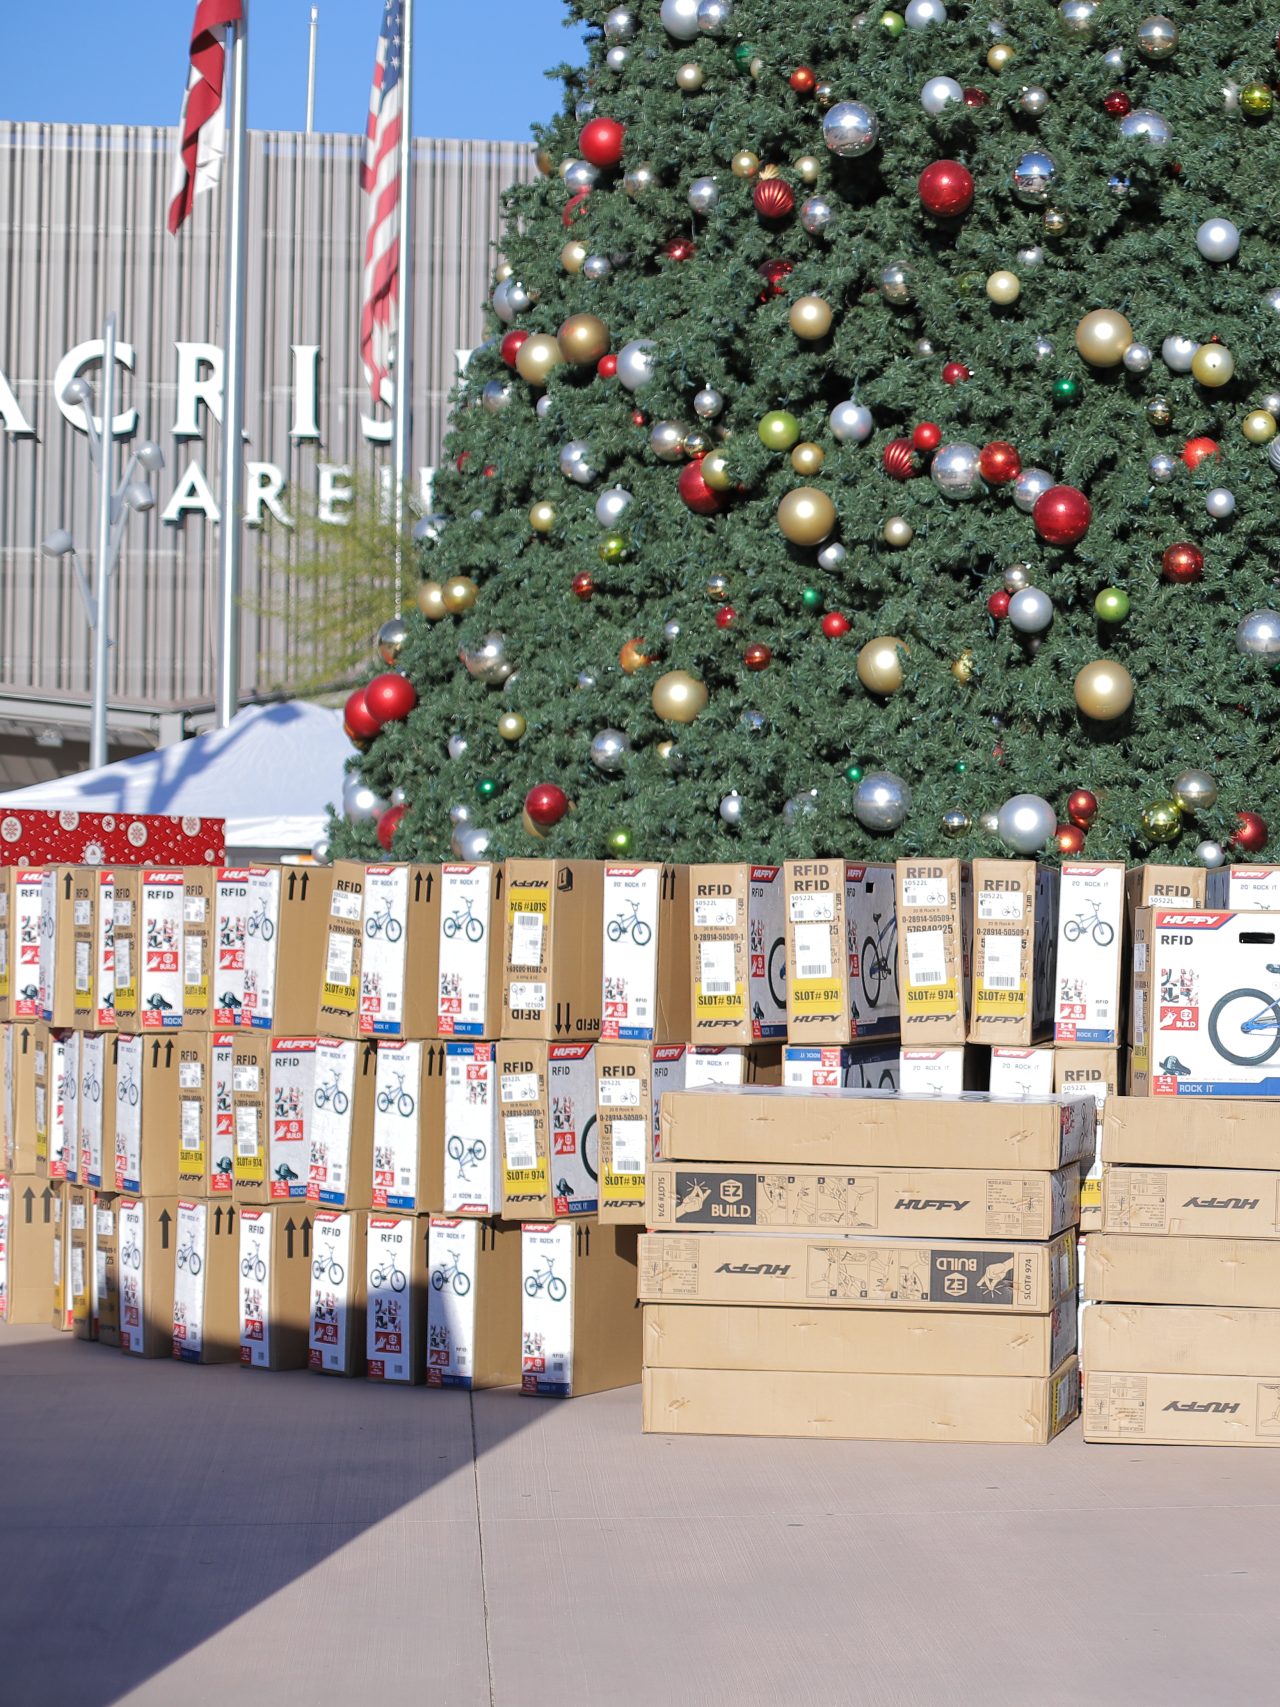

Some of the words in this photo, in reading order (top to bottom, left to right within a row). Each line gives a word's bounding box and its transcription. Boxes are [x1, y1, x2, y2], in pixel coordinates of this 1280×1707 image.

[793, 865, 829, 876] RFID
[906, 866, 943, 878] RFID
[186, 886, 204, 895] RFID
[337, 879, 363, 894] RFID
[697, 884, 732, 896] RFID
[794, 880, 830, 891] RFID
[984, 879, 1021, 891] RFID
[1154, 884, 1191, 897] RFID
[148, 891, 174, 900] RFID
[220, 889, 247, 898] RFID
[1162, 915, 1220, 926] HUFFY
[1161, 935, 1194, 945] RFID
[698, 995, 725, 1006] SLOT#
[726, 995, 741, 1005] 974
[794, 991, 821, 1001] SLOT#
[823, 990, 839, 1000] 974
[908, 990, 936, 1001] SLOT#
[938, 990, 954, 1000] 974
[978, 991, 1006, 1001] SLOT#
[1008, 992, 1024, 1002] 974
[320, 1006, 354, 1018] HUFFY
[512, 1009, 541, 1021] RFID
[793, 1014, 841, 1022] HUFFY
[906, 1014, 956, 1023] HUFFY
[976, 1015, 1024, 1023] HUFFY
[697, 1020, 743, 1028] HUFFY
[181, 1050, 198, 1060] RFID
[553, 1046, 584, 1055] HUFFY
[656, 1048, 681, 1058] HUFFY
[236, 1055, 257, 1065] RFID
[275, 1058, 300, 1067] RFID
[503, 1062, 533, 1073] RFID
[552, 1066, 570, 1076] RFID
[602, 1065, 636, 1077] RFID
[654, 1067, 669, 1077] RFID
[1064, 1070, 1102, 1081] RFID
[1180, 1084, 1200, 1093] ROCK
[1205, 1084, 1214, 1093] IT
[506, 1171, 530, 1181] SLOT#
[531, 1171, 545, 1180] 974
[604, 1175, 630, 1186] SLOT#
[632, 1176, 646, 1185] 974
[722, 1185, 741, 1197] EZ
[506, 1195, 547, 1203] HUFFY
[603, 1200, 646, 1208] HUFFY
[894, 1199, 970, 1210] HUFFY
[1182, 1196, 1260, 1209] HUFFY
[711, 1203, 752, 1218] BUILD
[249, 1225, 265, 1234] RFID
[322, 1227, 341, 1237] RFID
[380, 1233, 403, 1243] RFID
[715, 1263, 791, 1276] HUFFY
[936, 1258, 977, 1271] BUILD
[1023, 1258, 1032, 1273] 974
[946, 1278, 966, 1290] EZ
[1023, 1276, 1032, 1300] SLOT#
[1161, 1400, 1241, 1414] HUFFY
